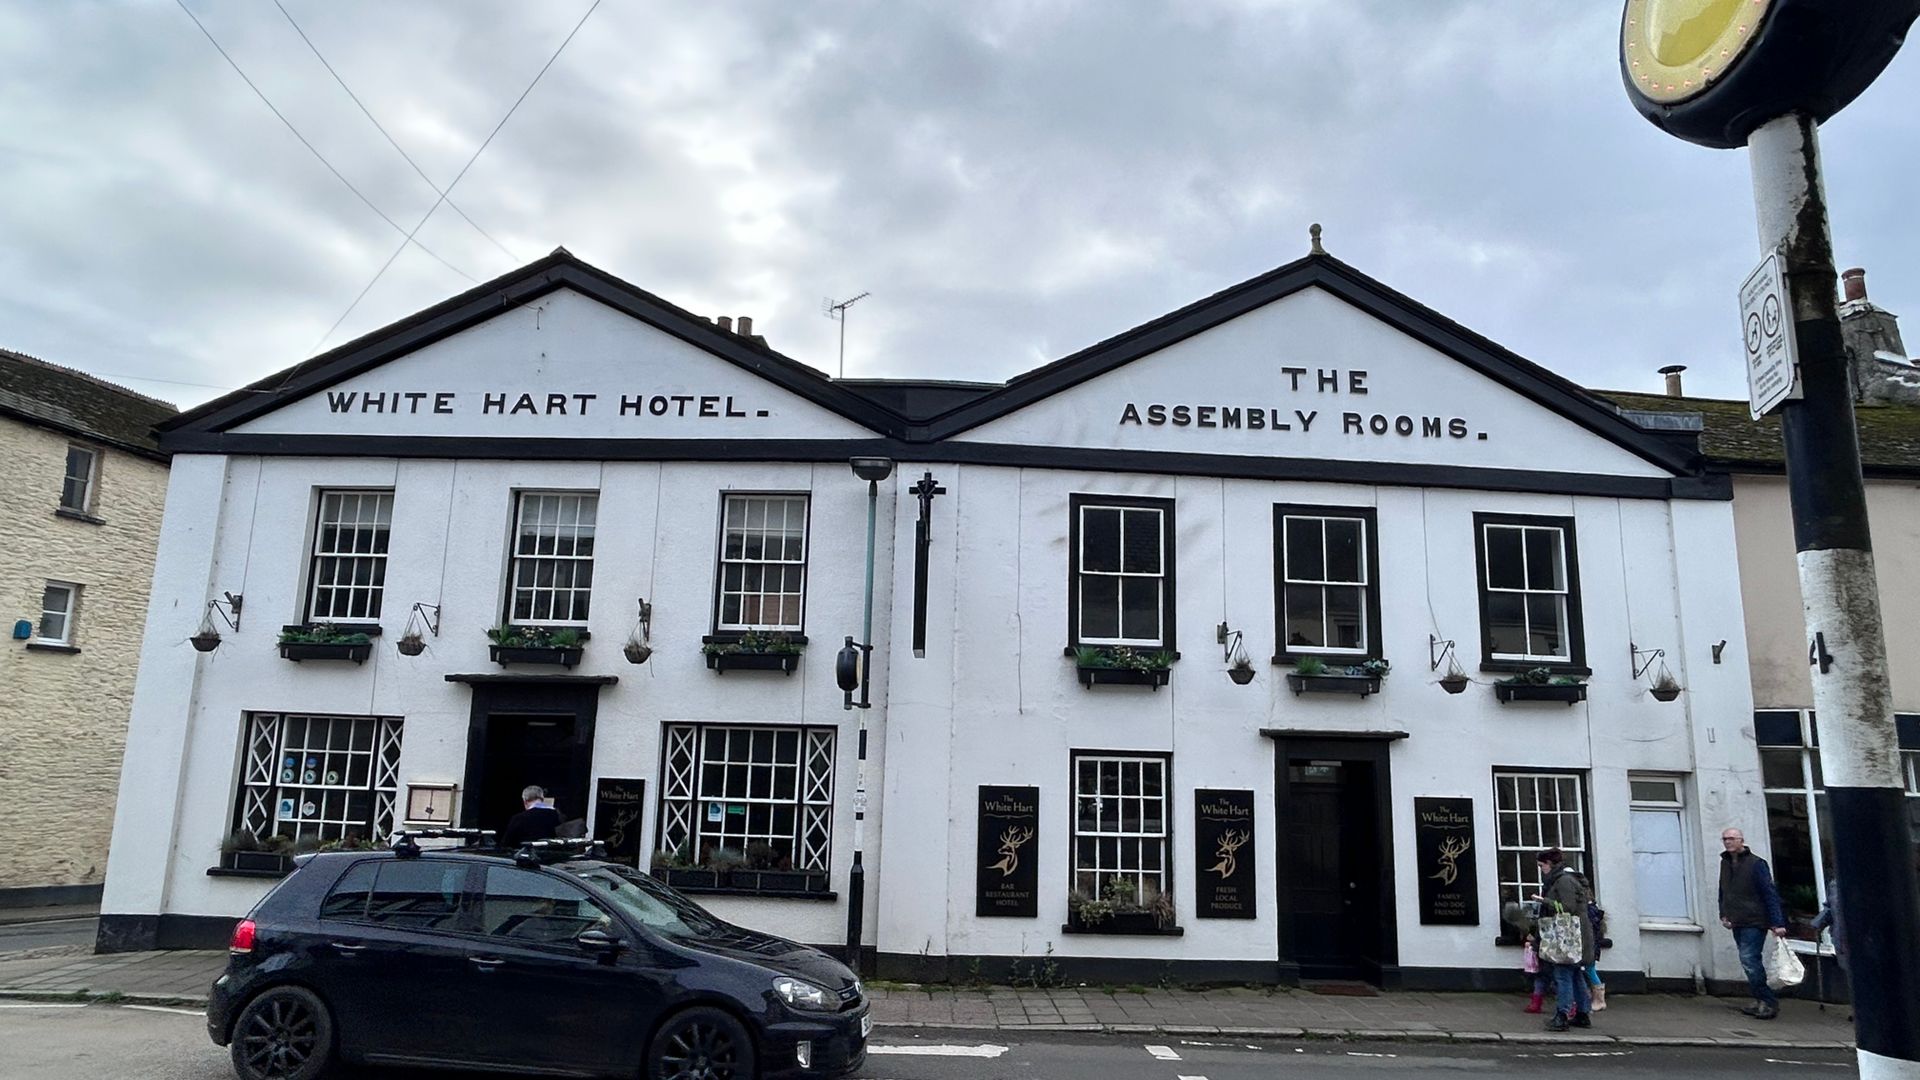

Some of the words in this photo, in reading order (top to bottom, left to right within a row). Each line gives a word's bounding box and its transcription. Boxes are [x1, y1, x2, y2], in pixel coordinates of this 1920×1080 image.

[1281, 367, 1368, 394] THE
[327, 391, 455, 414] WHITE
[482, 393, 597, 415] HART
[1119, 403, 1318, 432] ASSEMBLY
[984, 801, 1012, 812] White
[1013, 802, 1033, 812] Hart
[1201, 804, 1228, 814] White
[1229, 805, 1249, 816] Hart
[1422, 812, 1448, 822] White
[1449, 813, 1469, 823] Hart
[1215, 894, 1239, 902] LOCAL
[1210, 902, 1243, 910] PRODUCE
